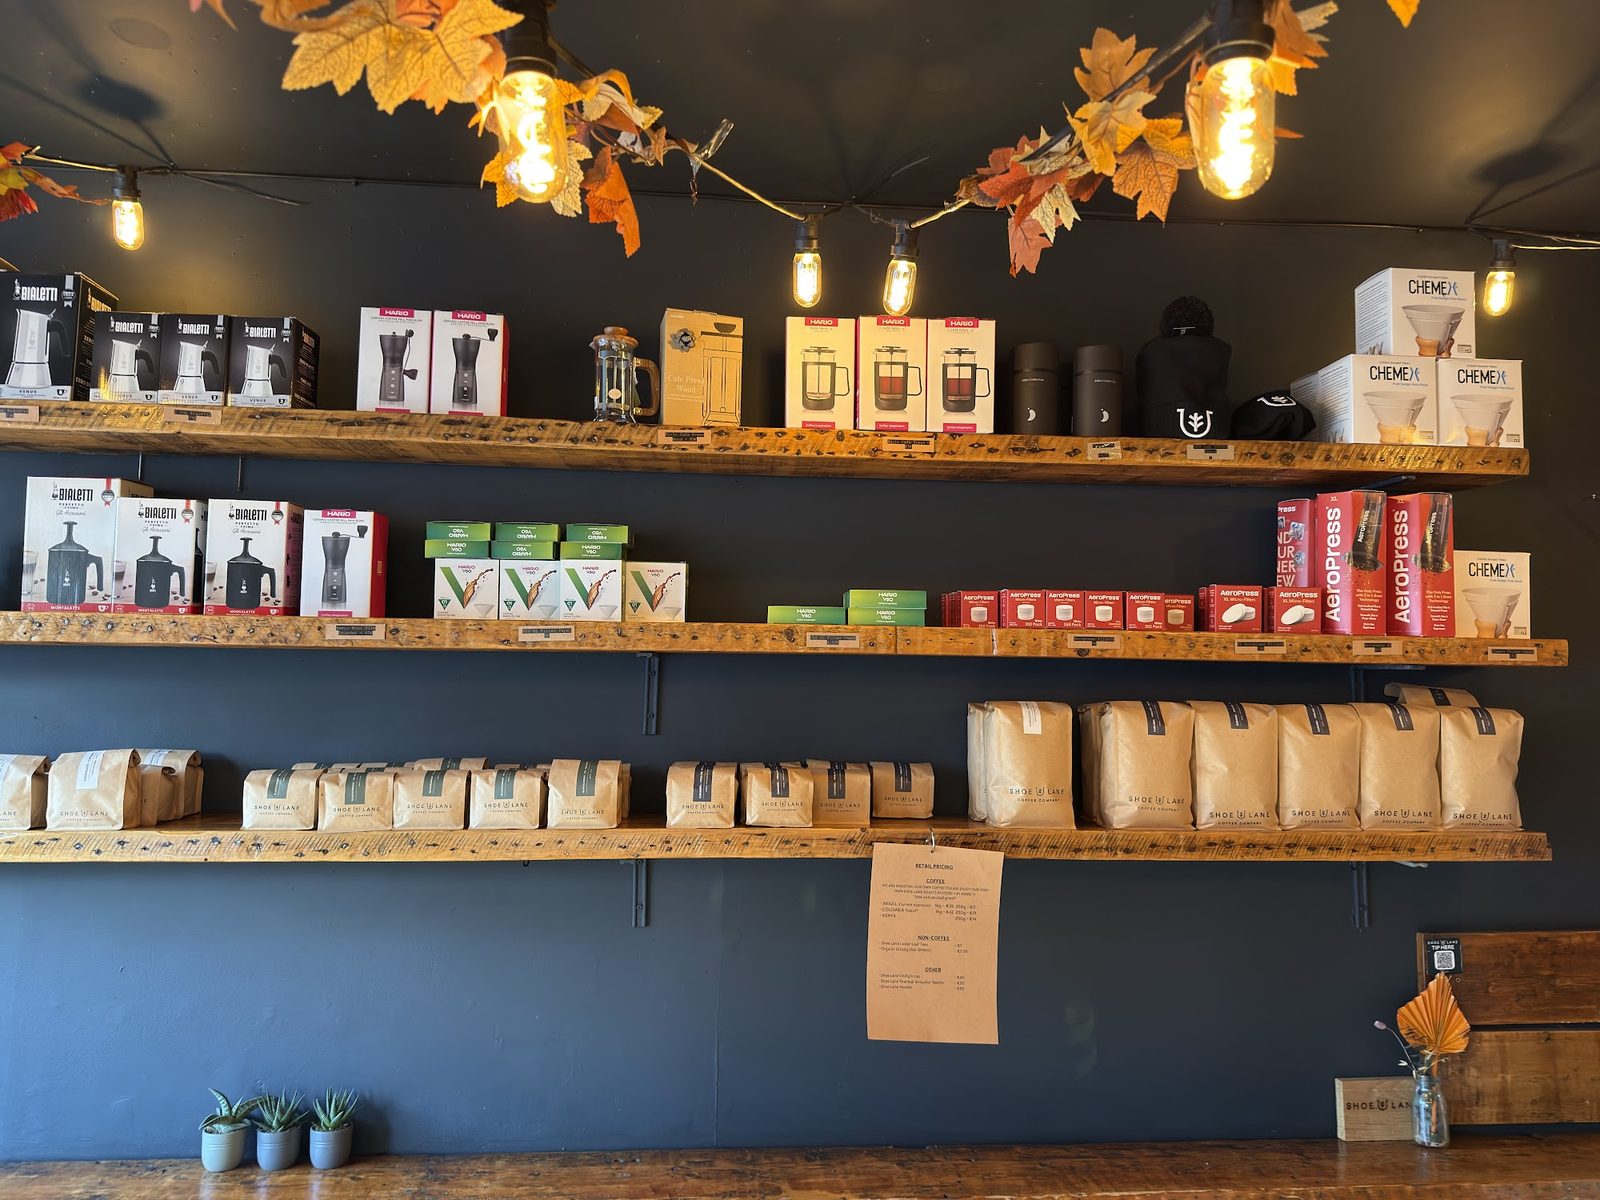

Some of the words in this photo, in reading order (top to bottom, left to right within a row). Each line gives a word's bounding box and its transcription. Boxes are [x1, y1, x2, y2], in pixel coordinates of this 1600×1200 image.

[1408, 280, 1458, 296] CHEMEX
[1369, 366, 1420, 381] CHEMEX
[1458, 369, 1506, 384] CHEMEX
[676, 385, 696, 393] Wood
[1358, 510, 1370, 542] AeroPress
[1325, 506, 1341, 622] AeroPress
[1394, 510, 1410, 624] AeroPress
[1468, 562, 1515, 578] CHEMEX
[1346, 1101, 1374, 1110] SHOE
